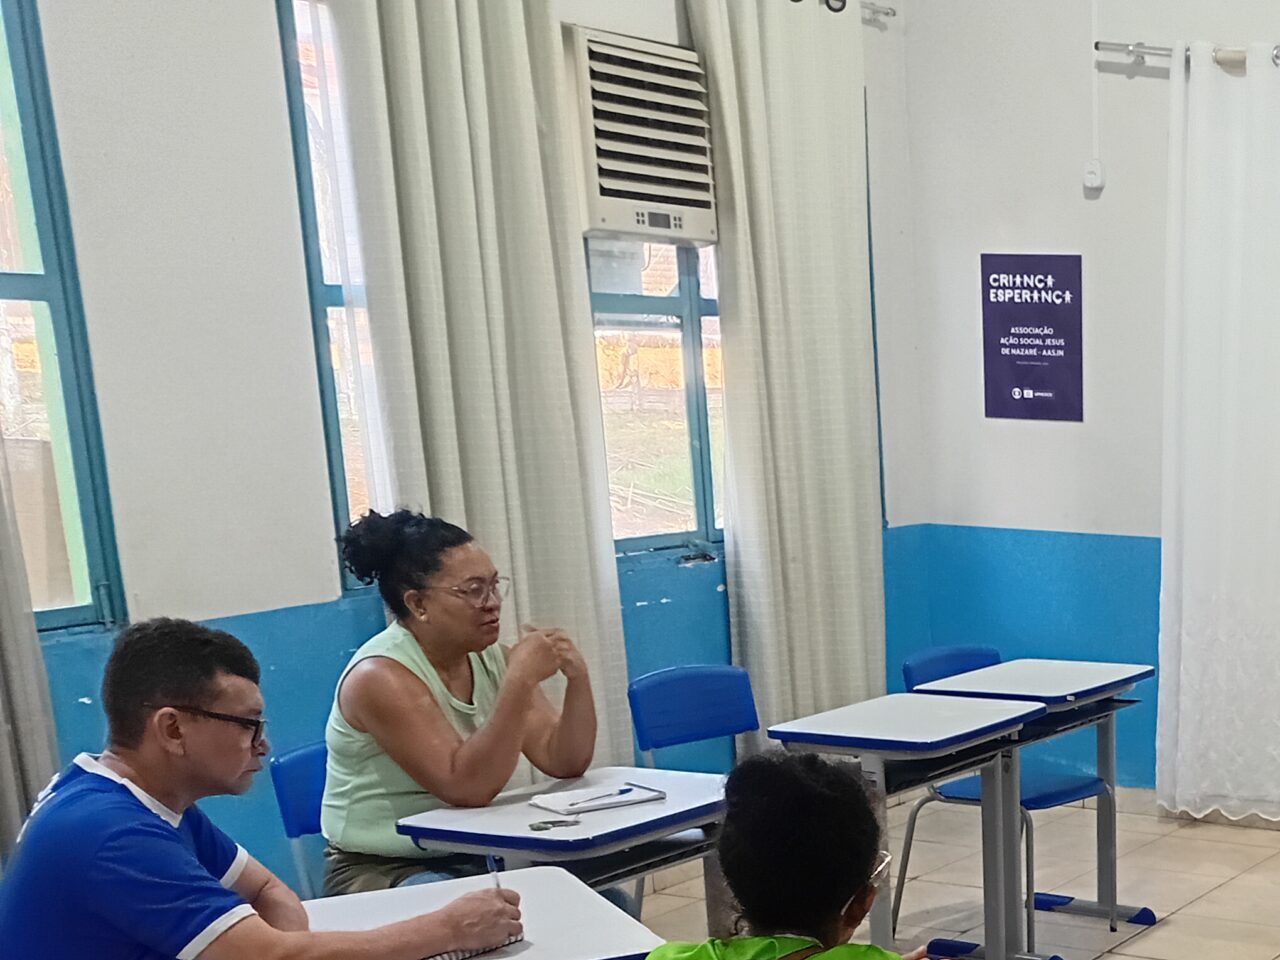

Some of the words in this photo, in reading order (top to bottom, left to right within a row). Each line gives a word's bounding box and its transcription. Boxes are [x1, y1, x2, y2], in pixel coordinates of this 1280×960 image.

[989, 274, 1055, 288] CRIANÇA
[989, 289, 1073, 304] ESPERANÇA
[1010, 326, 1054, 335] ASSOCIAÇÃO
[1000, 336, 1019, 346] AÇÃO
[1019, 337, 1044, 346] SOCIAL
[1044, 338, 1065, 346] JESUS
[1001, 347, 1010, 355] DE
[1011, 347, 1037, 356] NAZARÉ
